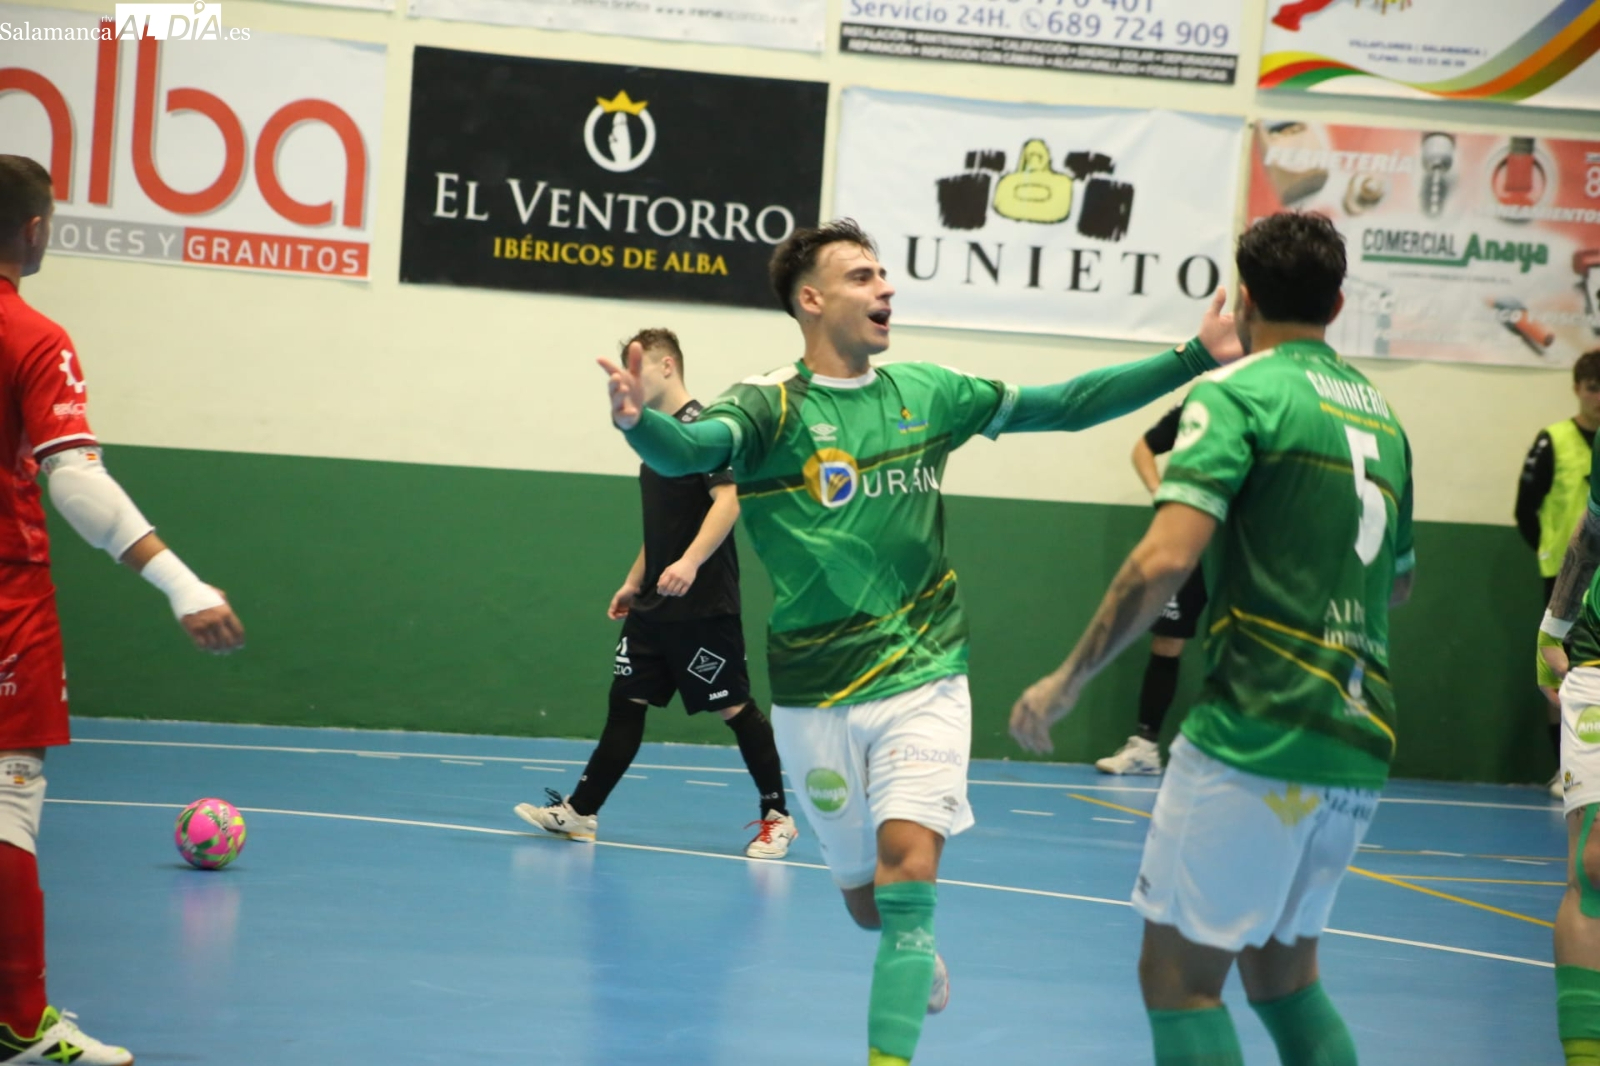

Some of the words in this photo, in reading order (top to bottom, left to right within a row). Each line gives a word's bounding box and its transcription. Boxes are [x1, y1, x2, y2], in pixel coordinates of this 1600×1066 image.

[850, 0, 947, 23] Servicio
[1047, 11, 1101, 38] 689
[1114, 16, 1164, 42] 724
[1175, 21, 1229, 48] 909
[507, 178, 795, 245] VENTORRO
[159, 232, 177, 256] Y
[187, 236, 360, 273] GRANITOS
[493, 235, 614, 266] IBÉRICOS
[623, 248, 657, 270] DE
[664, 252, 728, 276] ALBA
[904, 236, 1221, 300] UNIETO
[1363, 229, 1456, 256] COMERCIAL
[1468, 233, 1549, 274] Anaya
[1344, 424, 1387, 566] 5
[709, 689, 729, 700] JAKO
